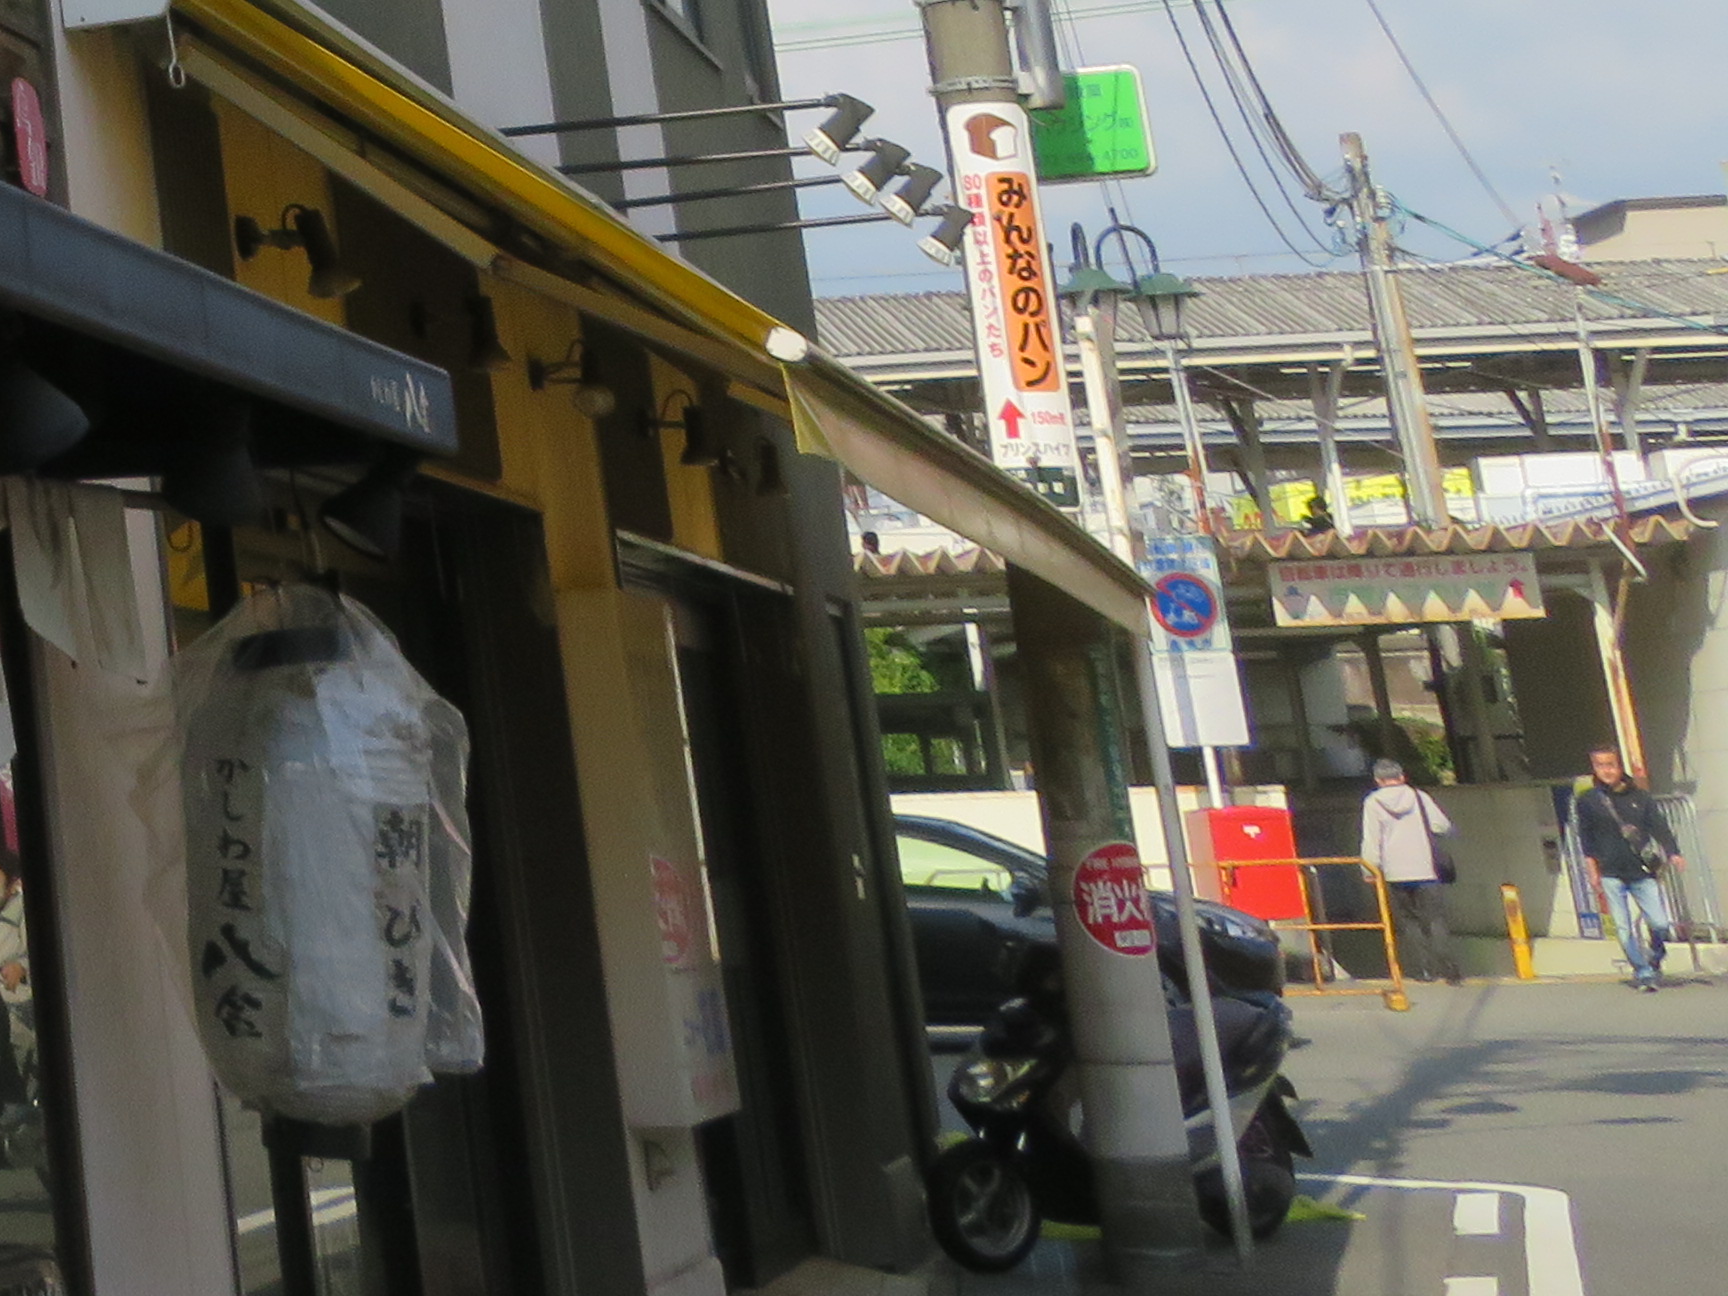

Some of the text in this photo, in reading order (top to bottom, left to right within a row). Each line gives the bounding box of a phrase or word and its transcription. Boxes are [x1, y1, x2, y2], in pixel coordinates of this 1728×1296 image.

[994, 176, 1052, 388] みんなのパン
[215, 758, 252, 911] かしわ屋
